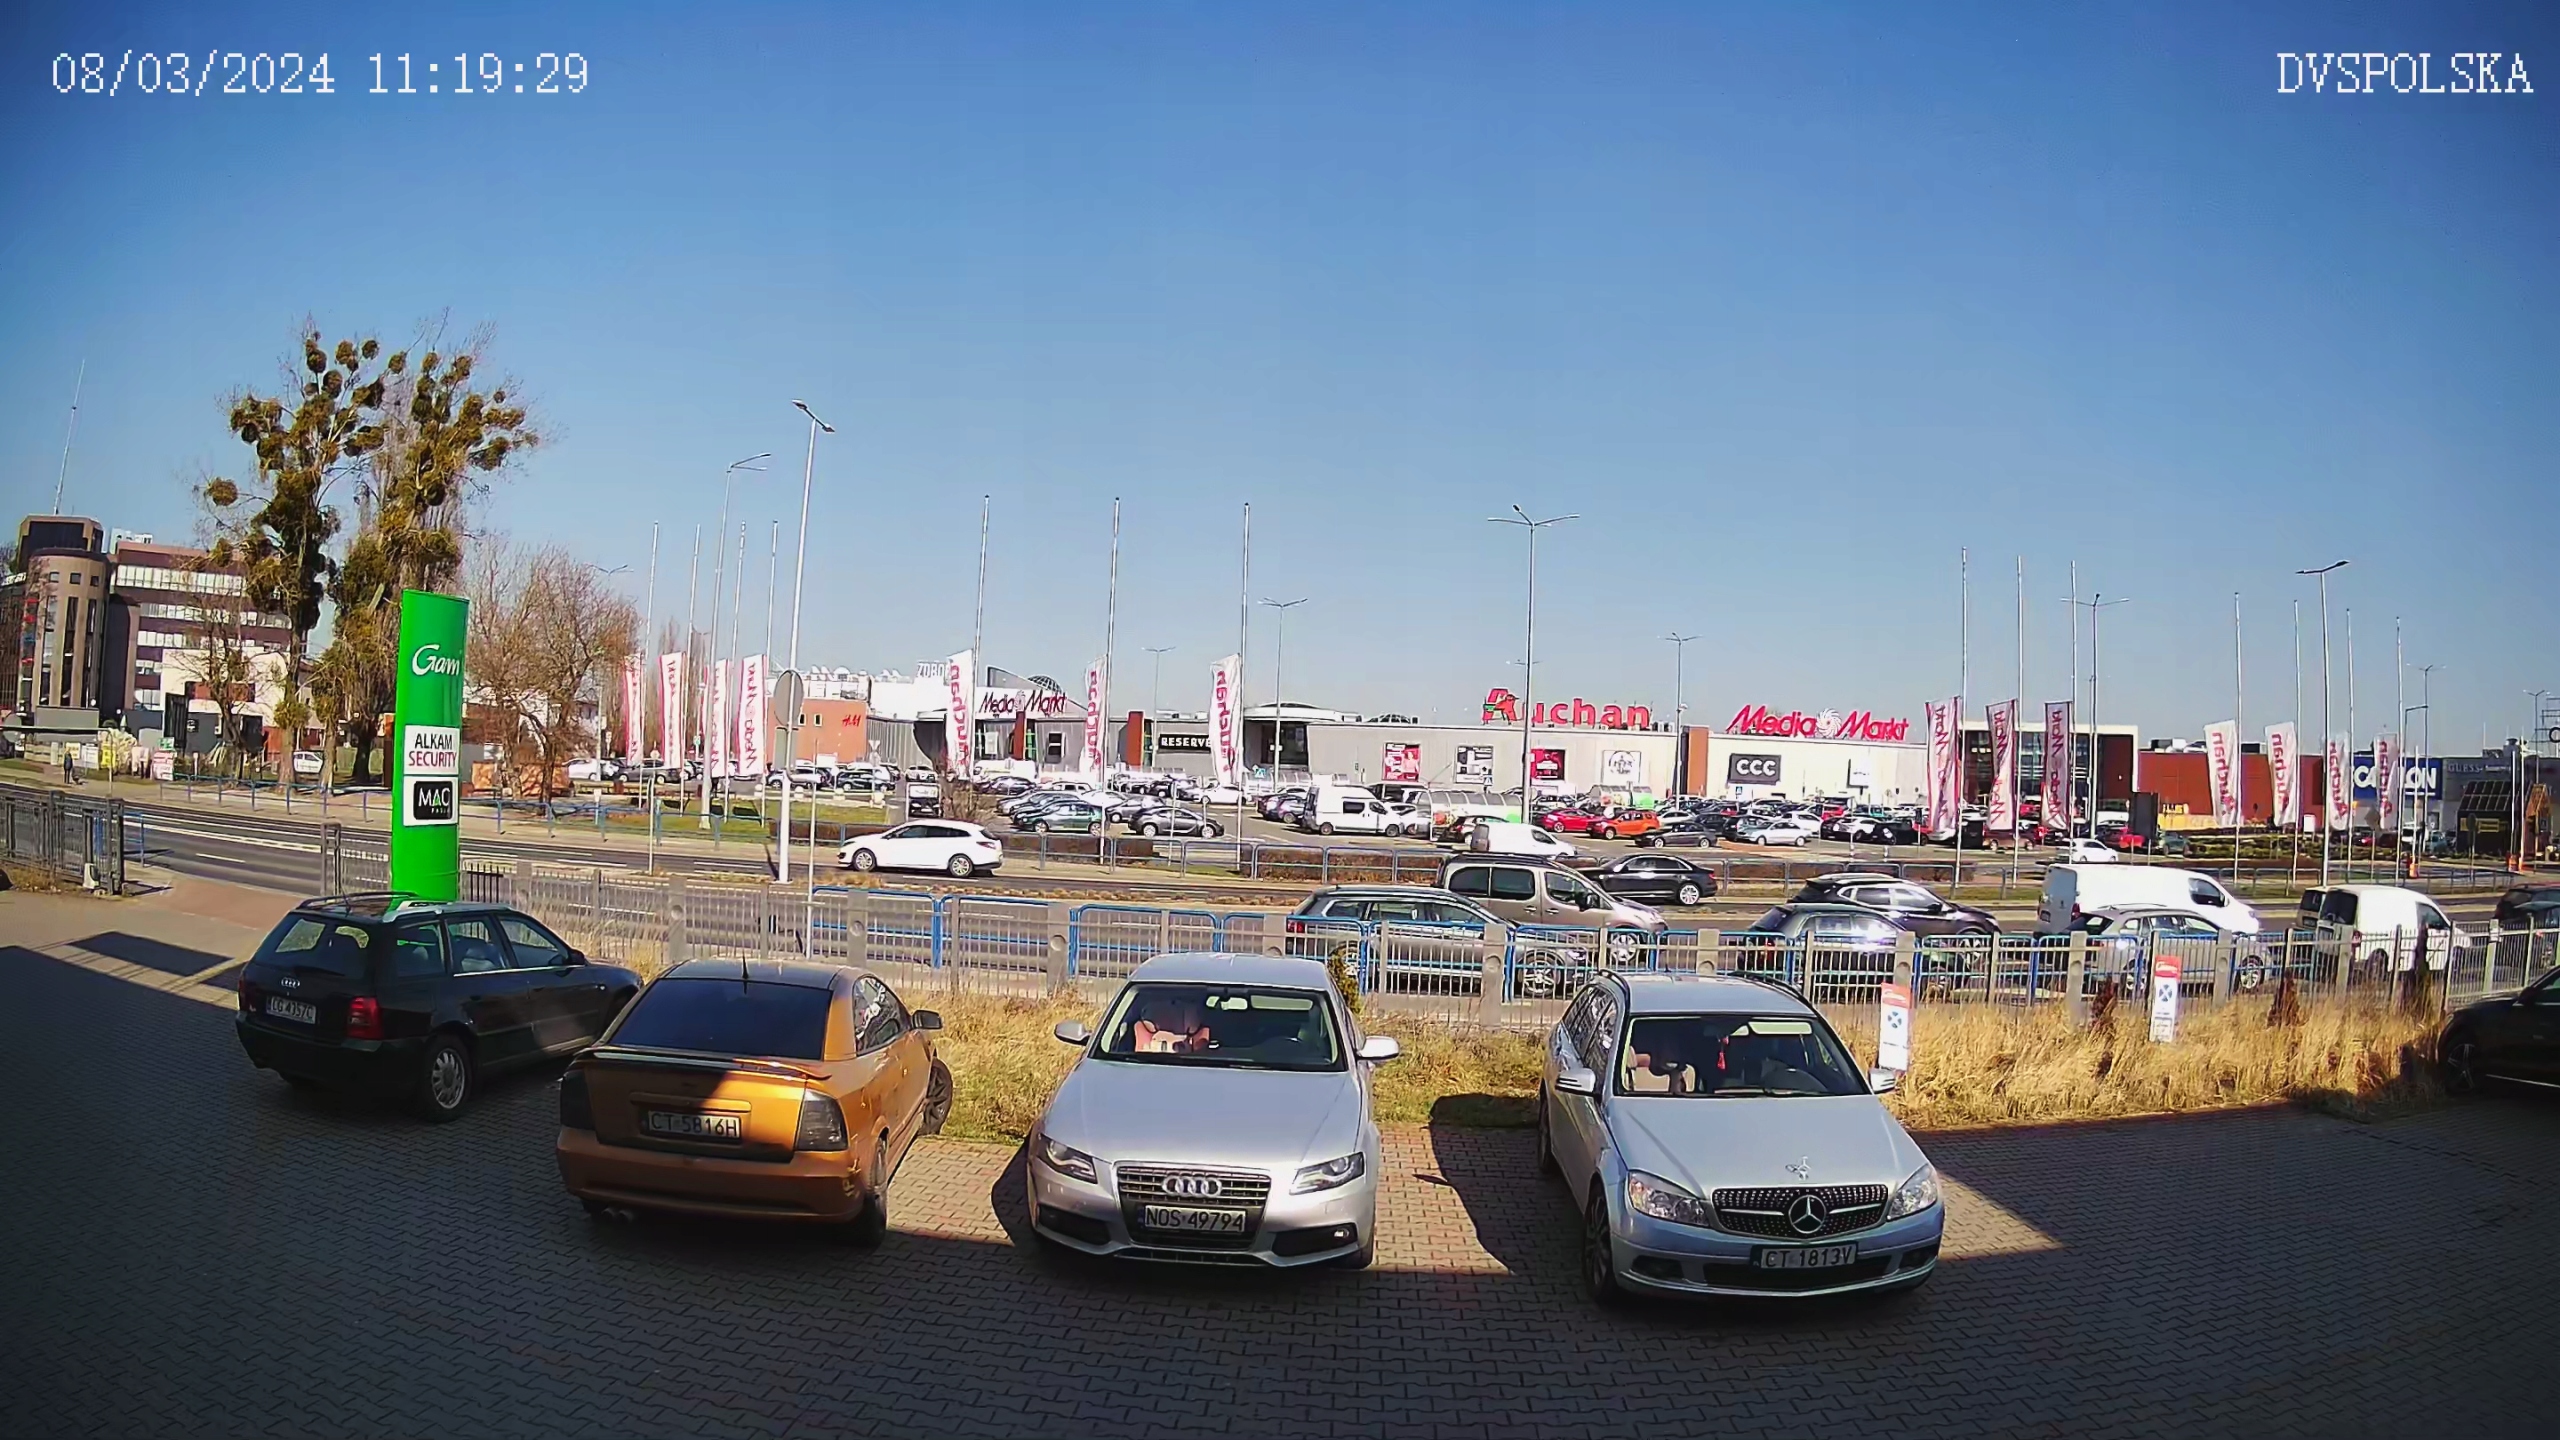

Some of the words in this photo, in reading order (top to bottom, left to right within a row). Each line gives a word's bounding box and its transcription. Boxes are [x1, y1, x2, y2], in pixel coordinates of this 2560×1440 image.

[979, 691, 1015, 714] Media
[1025, 689, 1066, 713] Markt
[1482, 687, 1651, 729] Auchan
[1726, 704, 1817, 738] Media
[1836, 710, 1909, 741] Markt
[414, 733, 453, 751] ALKAM
[1161, 737, 1211, 748] RESERVE
[408, 751, 457, 768] SECURITY
[1736, 759, 1777, 777] CCC
[651, 1113, 673, 1131] CT
[683, 1117, 738, 1137] 5816H
[1146, 1208, 1181, 1227] NOS
[1187, 1211, 1244, 1231] 49794
[1765, 1250, 1791, 1268] CT
